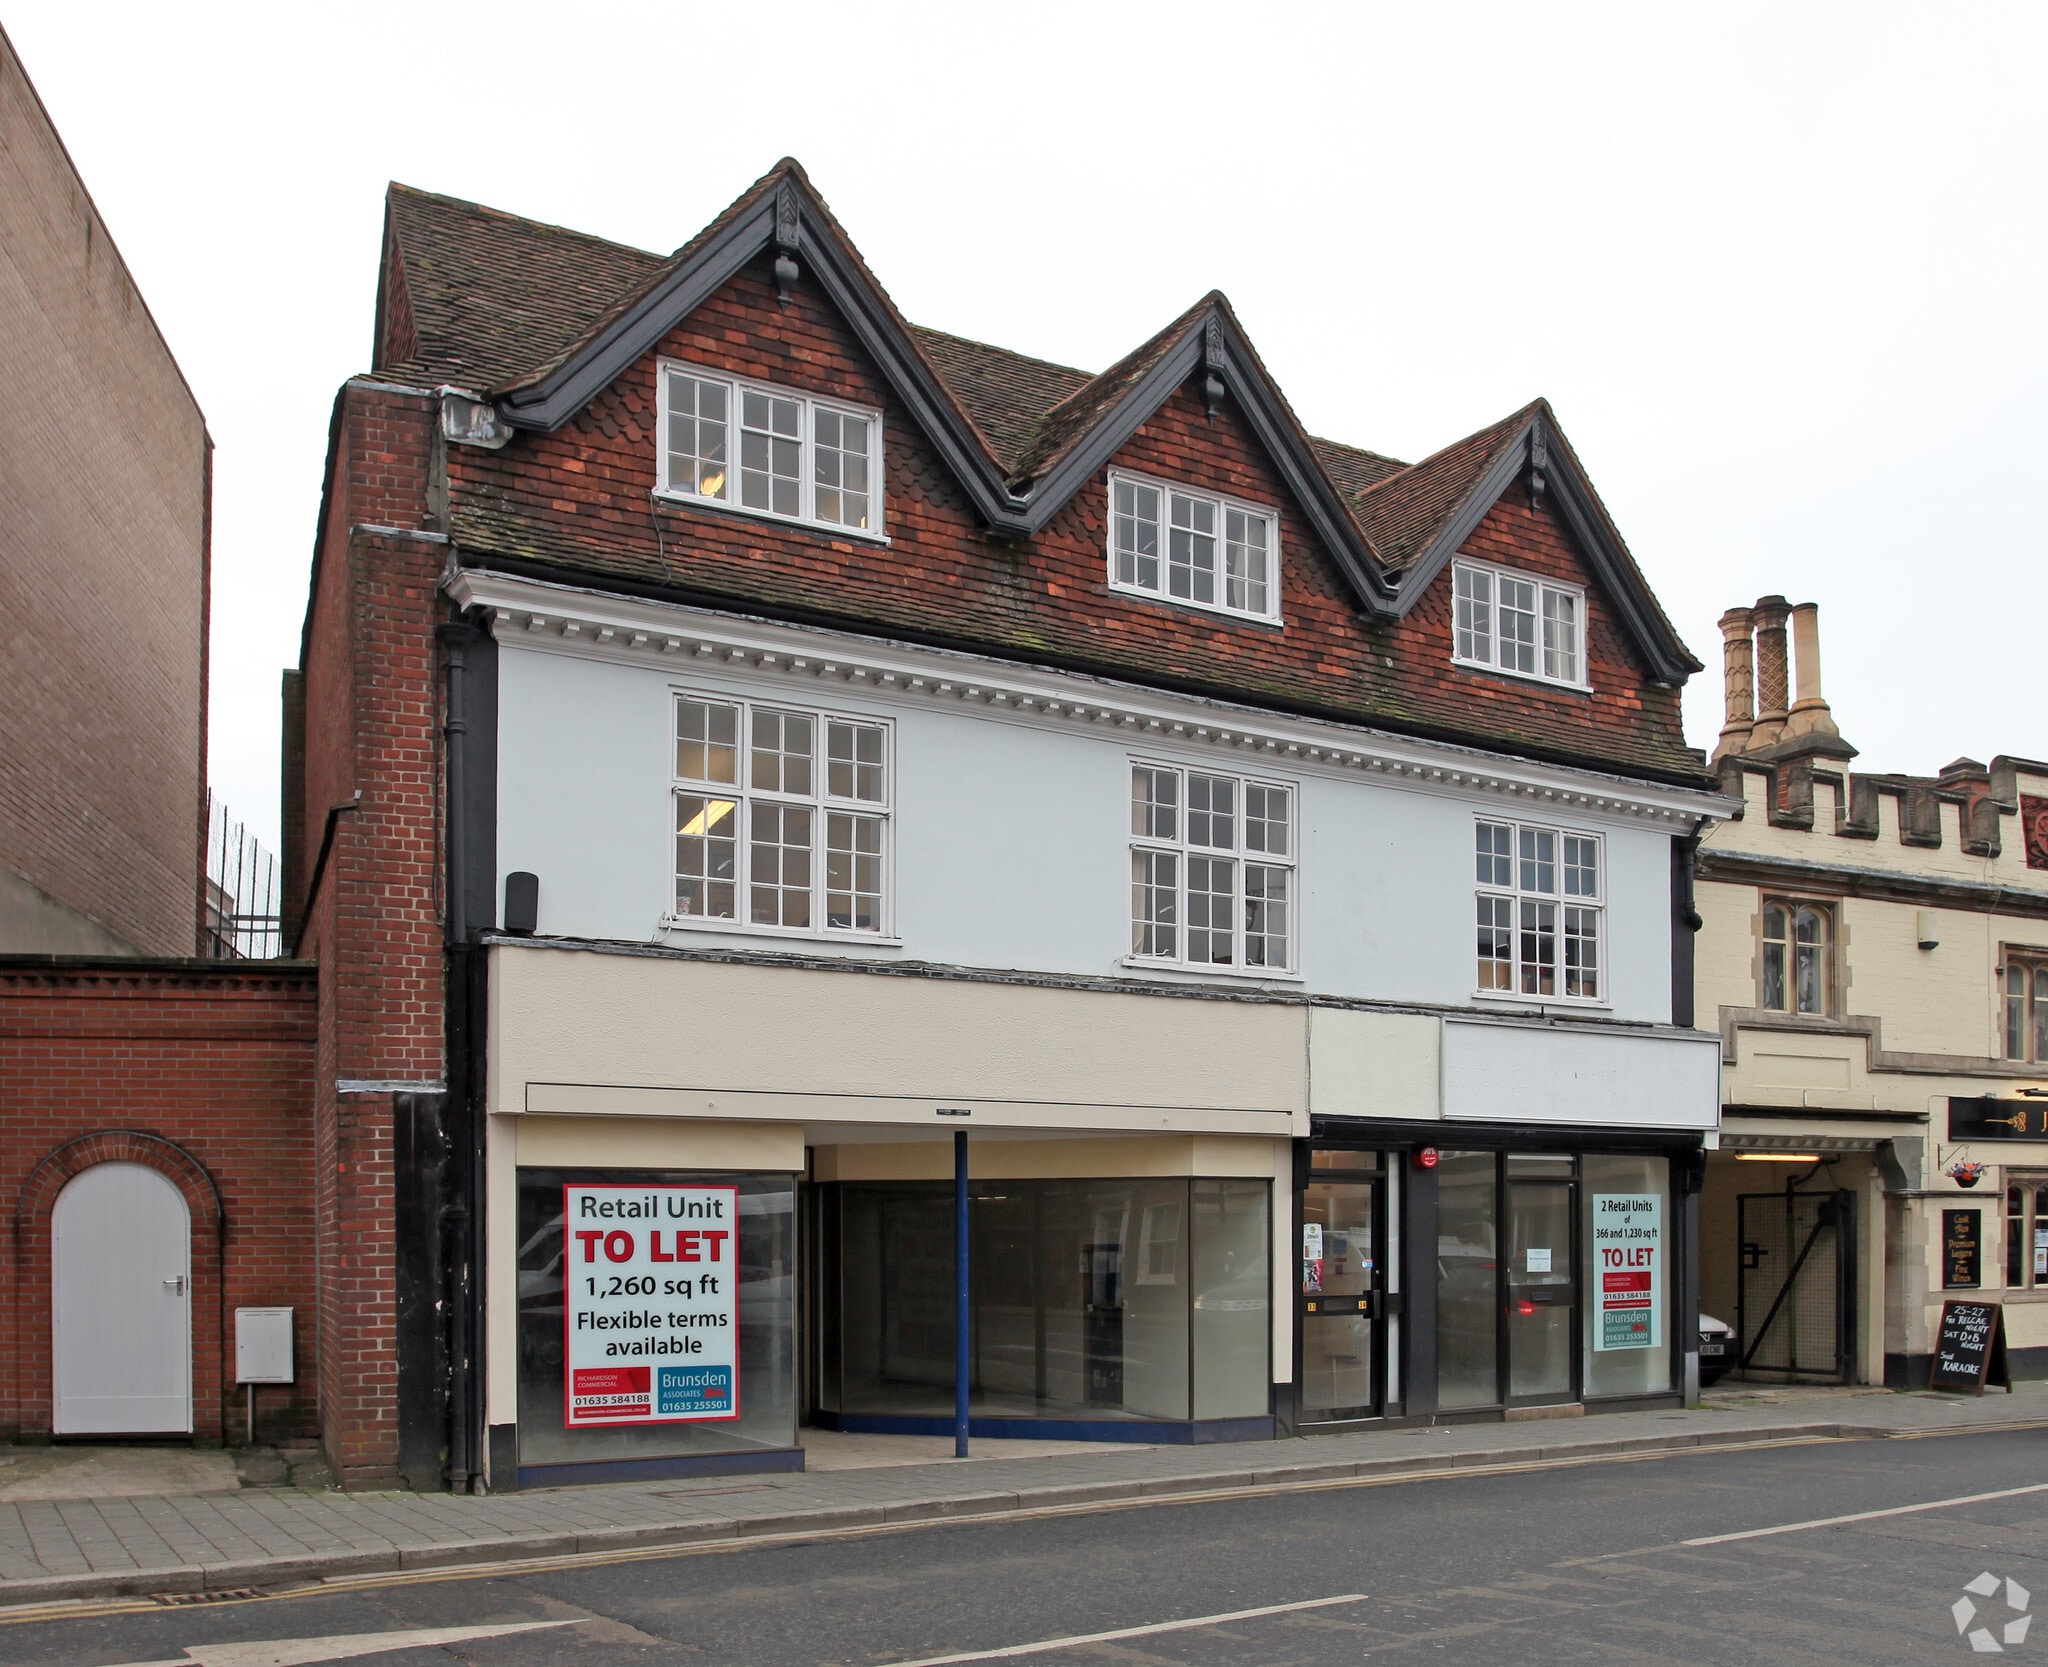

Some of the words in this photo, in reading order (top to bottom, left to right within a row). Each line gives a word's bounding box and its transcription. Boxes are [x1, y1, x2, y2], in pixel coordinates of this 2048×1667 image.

[581, 1195, 658, 1218] Retail
[667, 1196, 723, 1218] Unit
[1601, 1200, 1607, 1212] 2
[1608, 1200, 1631, 1212] Retail
[1632, 1200, 1653, 1212] Units
[1624, 1215, 1631, 1223] of
[1596, 1228, 1609, 1238] 366
[1610, 1228, 1623, 1238] and
[1624, 1228, 1642, 1239] 1,230
[1643, 1230, 1651, 1240] sq
[1652, 1227, 1658, 1238] ft
[575, 1230, 635, 1263] TO
[650, 1230, 728, 1262] LET
[1602, 1248, 1623, 1267] TO
[1627, 1248, 1654, 1266] LET
[585, 1276, 656, 1299] 1,260
[664, 1279, 692, 1299] sq
[699, 1274, 719, 1294] ft
[577, 1310, 662, 1330] Flexible
[667, 1311, 728, 1328] terms
[1605, 1310, 1648, 1324] Brunsden
[1944, 1330, 1959, 1338] SAT
[606, 1335, 703, 1356] available
[1942, 1360, 1980, 1375] KARAOKE
[663, 1371, 726, 1388] Brunsden
[575, 1396, 608, 1406] 01635
[611, 1394, 650, 1405] 584188
[663, 1390, 701, 1398] ASSOCIATES
[662, 1402, 691, 1411] 01635
[693, 1400, 727, 1410] 255501
